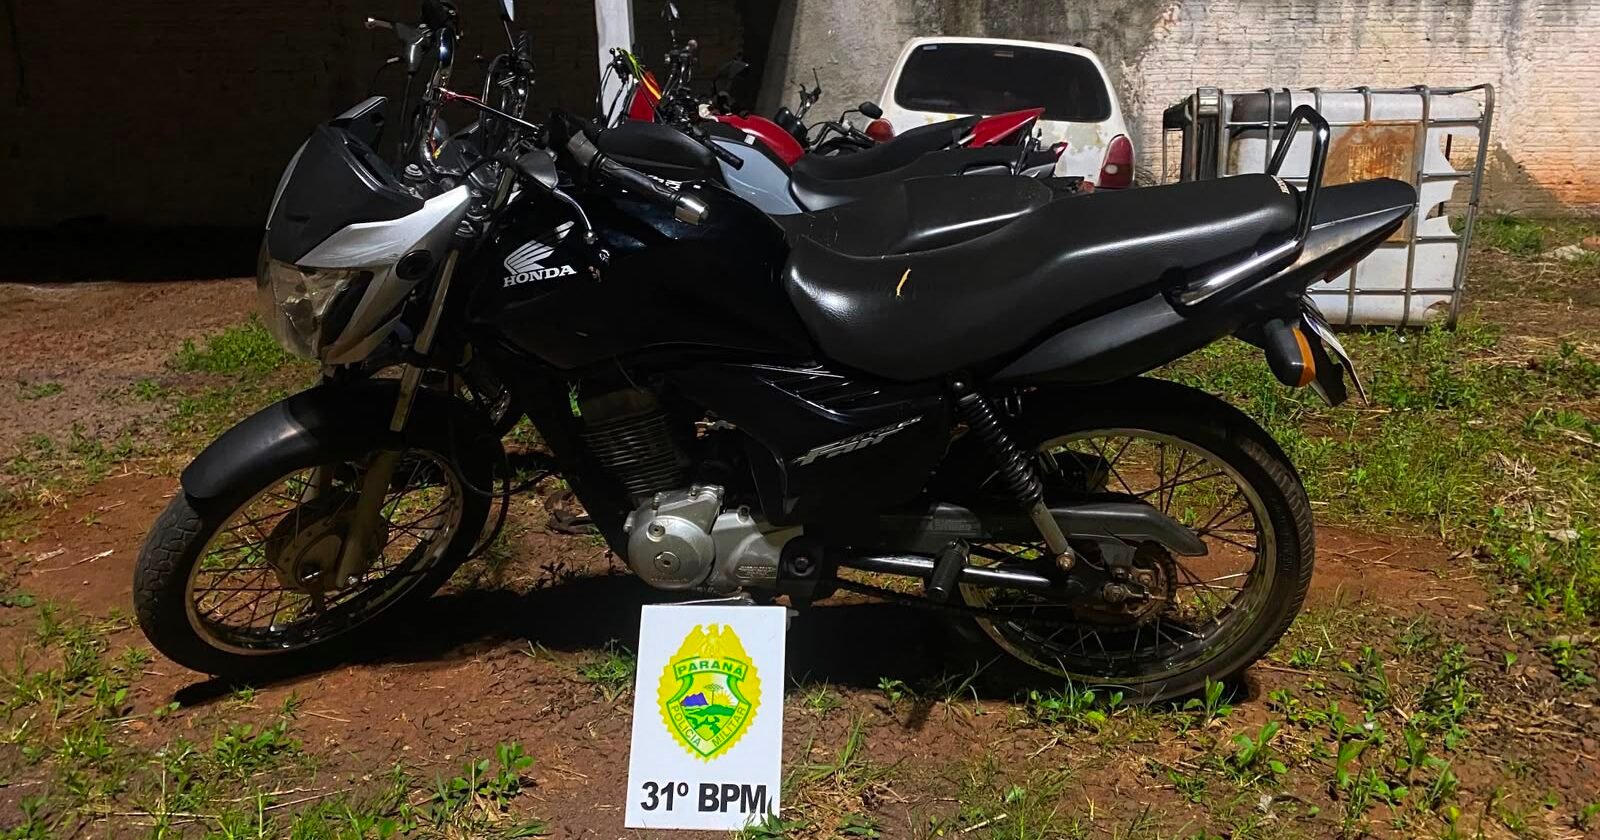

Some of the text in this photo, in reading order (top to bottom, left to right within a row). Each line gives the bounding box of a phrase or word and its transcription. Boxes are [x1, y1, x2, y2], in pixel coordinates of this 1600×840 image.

[503, 264, 577, 288] HONDA
[712, 705, 747, 747] MILITAR
[698, 783, 767, 813] BPM
